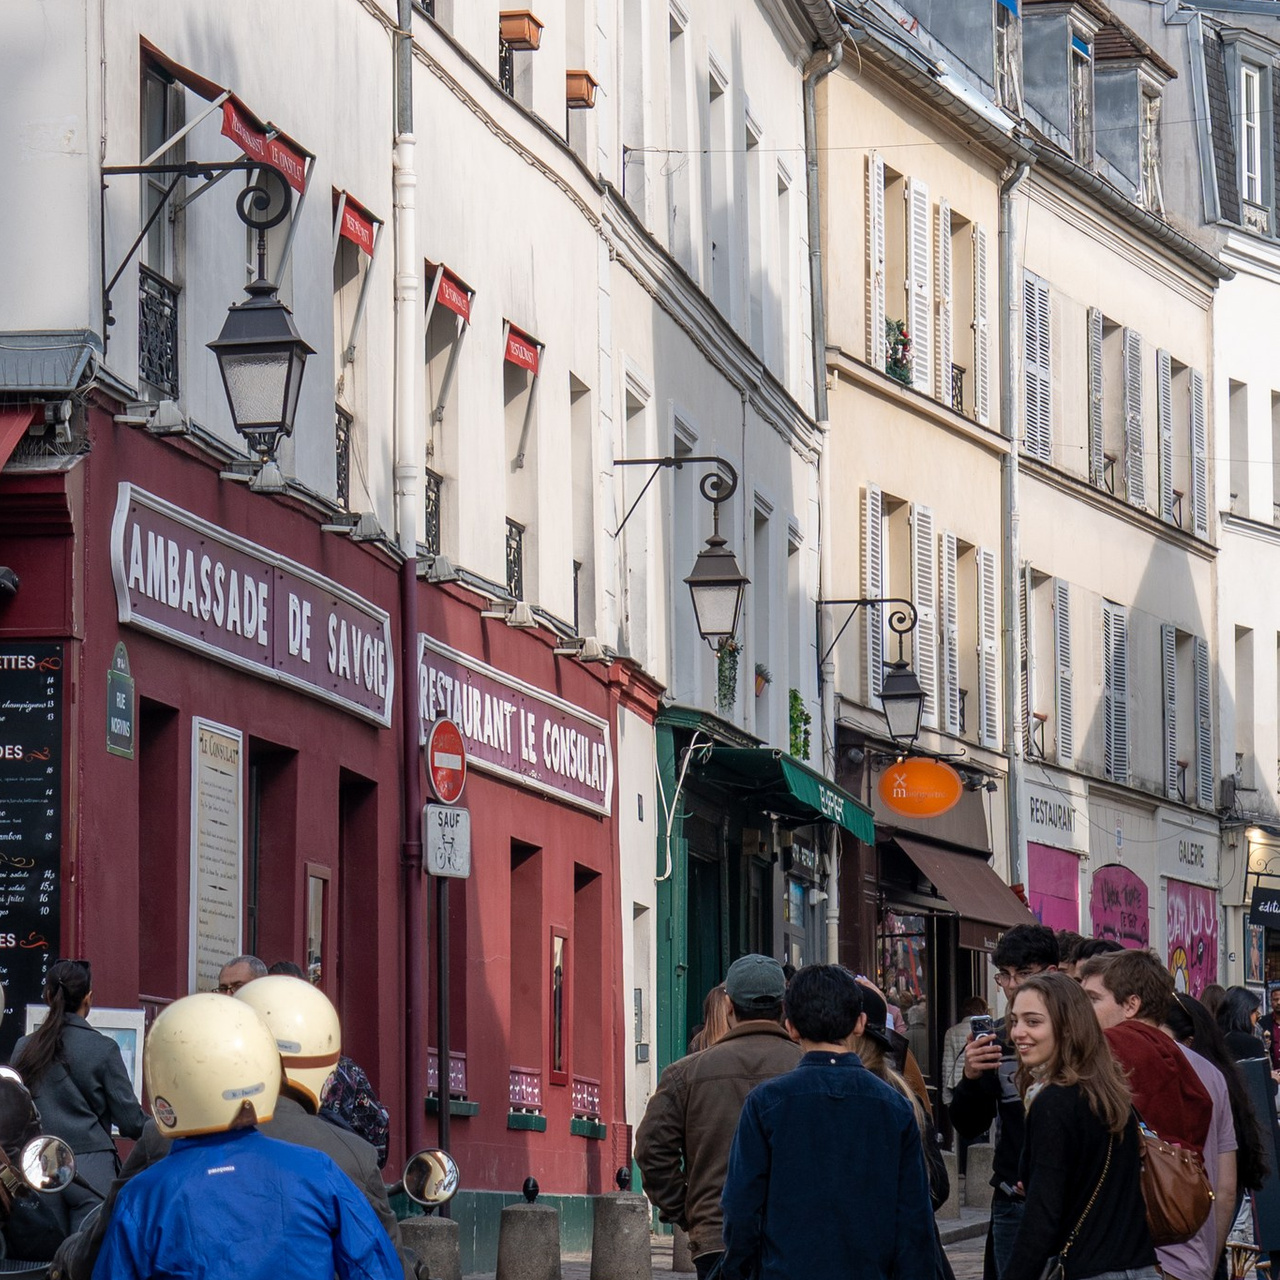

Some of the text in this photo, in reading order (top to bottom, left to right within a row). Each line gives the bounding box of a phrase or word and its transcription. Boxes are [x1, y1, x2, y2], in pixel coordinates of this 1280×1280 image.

[128, 523, 385, 699] AMBASSADE DE SAVOIE
[116, 692, 126, 710] RUE
[111, 716, 131, 737] NORVINS
[420, 663, 606, 792] RESTAURANT LE CONSULAT
[438, 811, 460, 827] SAUF
[1030, 796, 1076, 833] RESTAURANT
[1178, 840, 1204, 868] GALERIE
[40, 907, 49, 915] 10
[208, 1165, 235, 1175] patagonia
